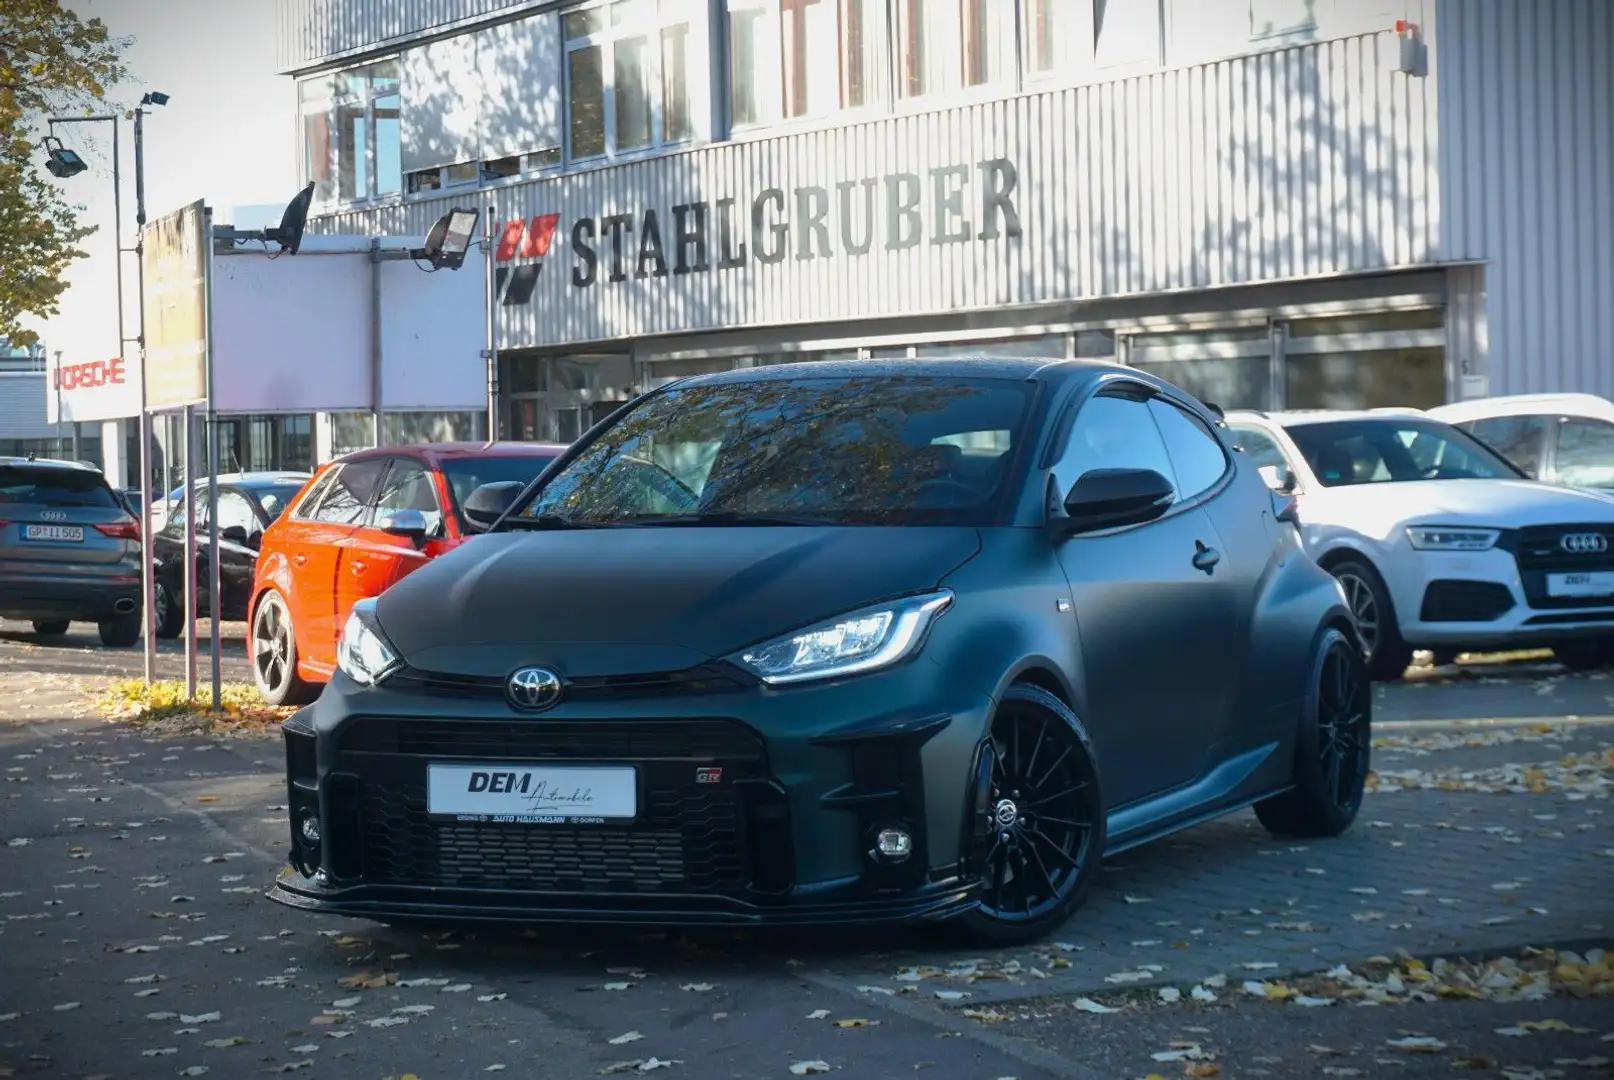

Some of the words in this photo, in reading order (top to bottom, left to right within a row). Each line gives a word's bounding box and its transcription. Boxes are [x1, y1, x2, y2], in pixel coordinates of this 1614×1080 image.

[571, 157, 1023, 288] STAHLGRUBER
[28, 526, 42, 537] GP
[468, 772, 532, 793] DEM
[492, 815, 515, 823] AUTO
[516, 815, 565, 824] HAUSMANN
